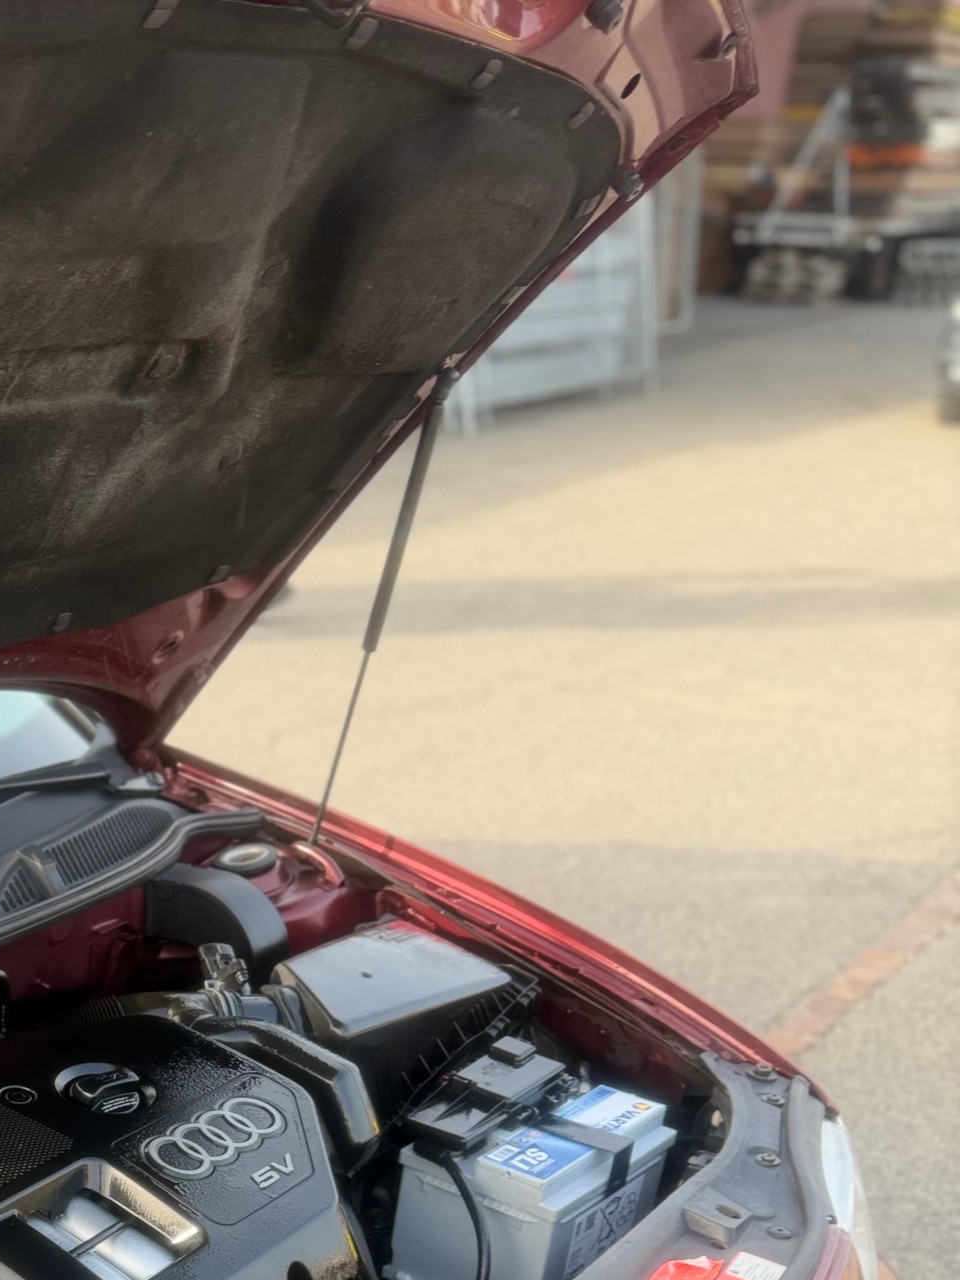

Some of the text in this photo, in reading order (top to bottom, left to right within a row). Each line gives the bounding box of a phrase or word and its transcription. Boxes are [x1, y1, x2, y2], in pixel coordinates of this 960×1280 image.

[602, 1110, 641, 1133] VARTA
[250, 1153, 294, 1189] 5V
[510, 1147, 549, 1171] SLI
